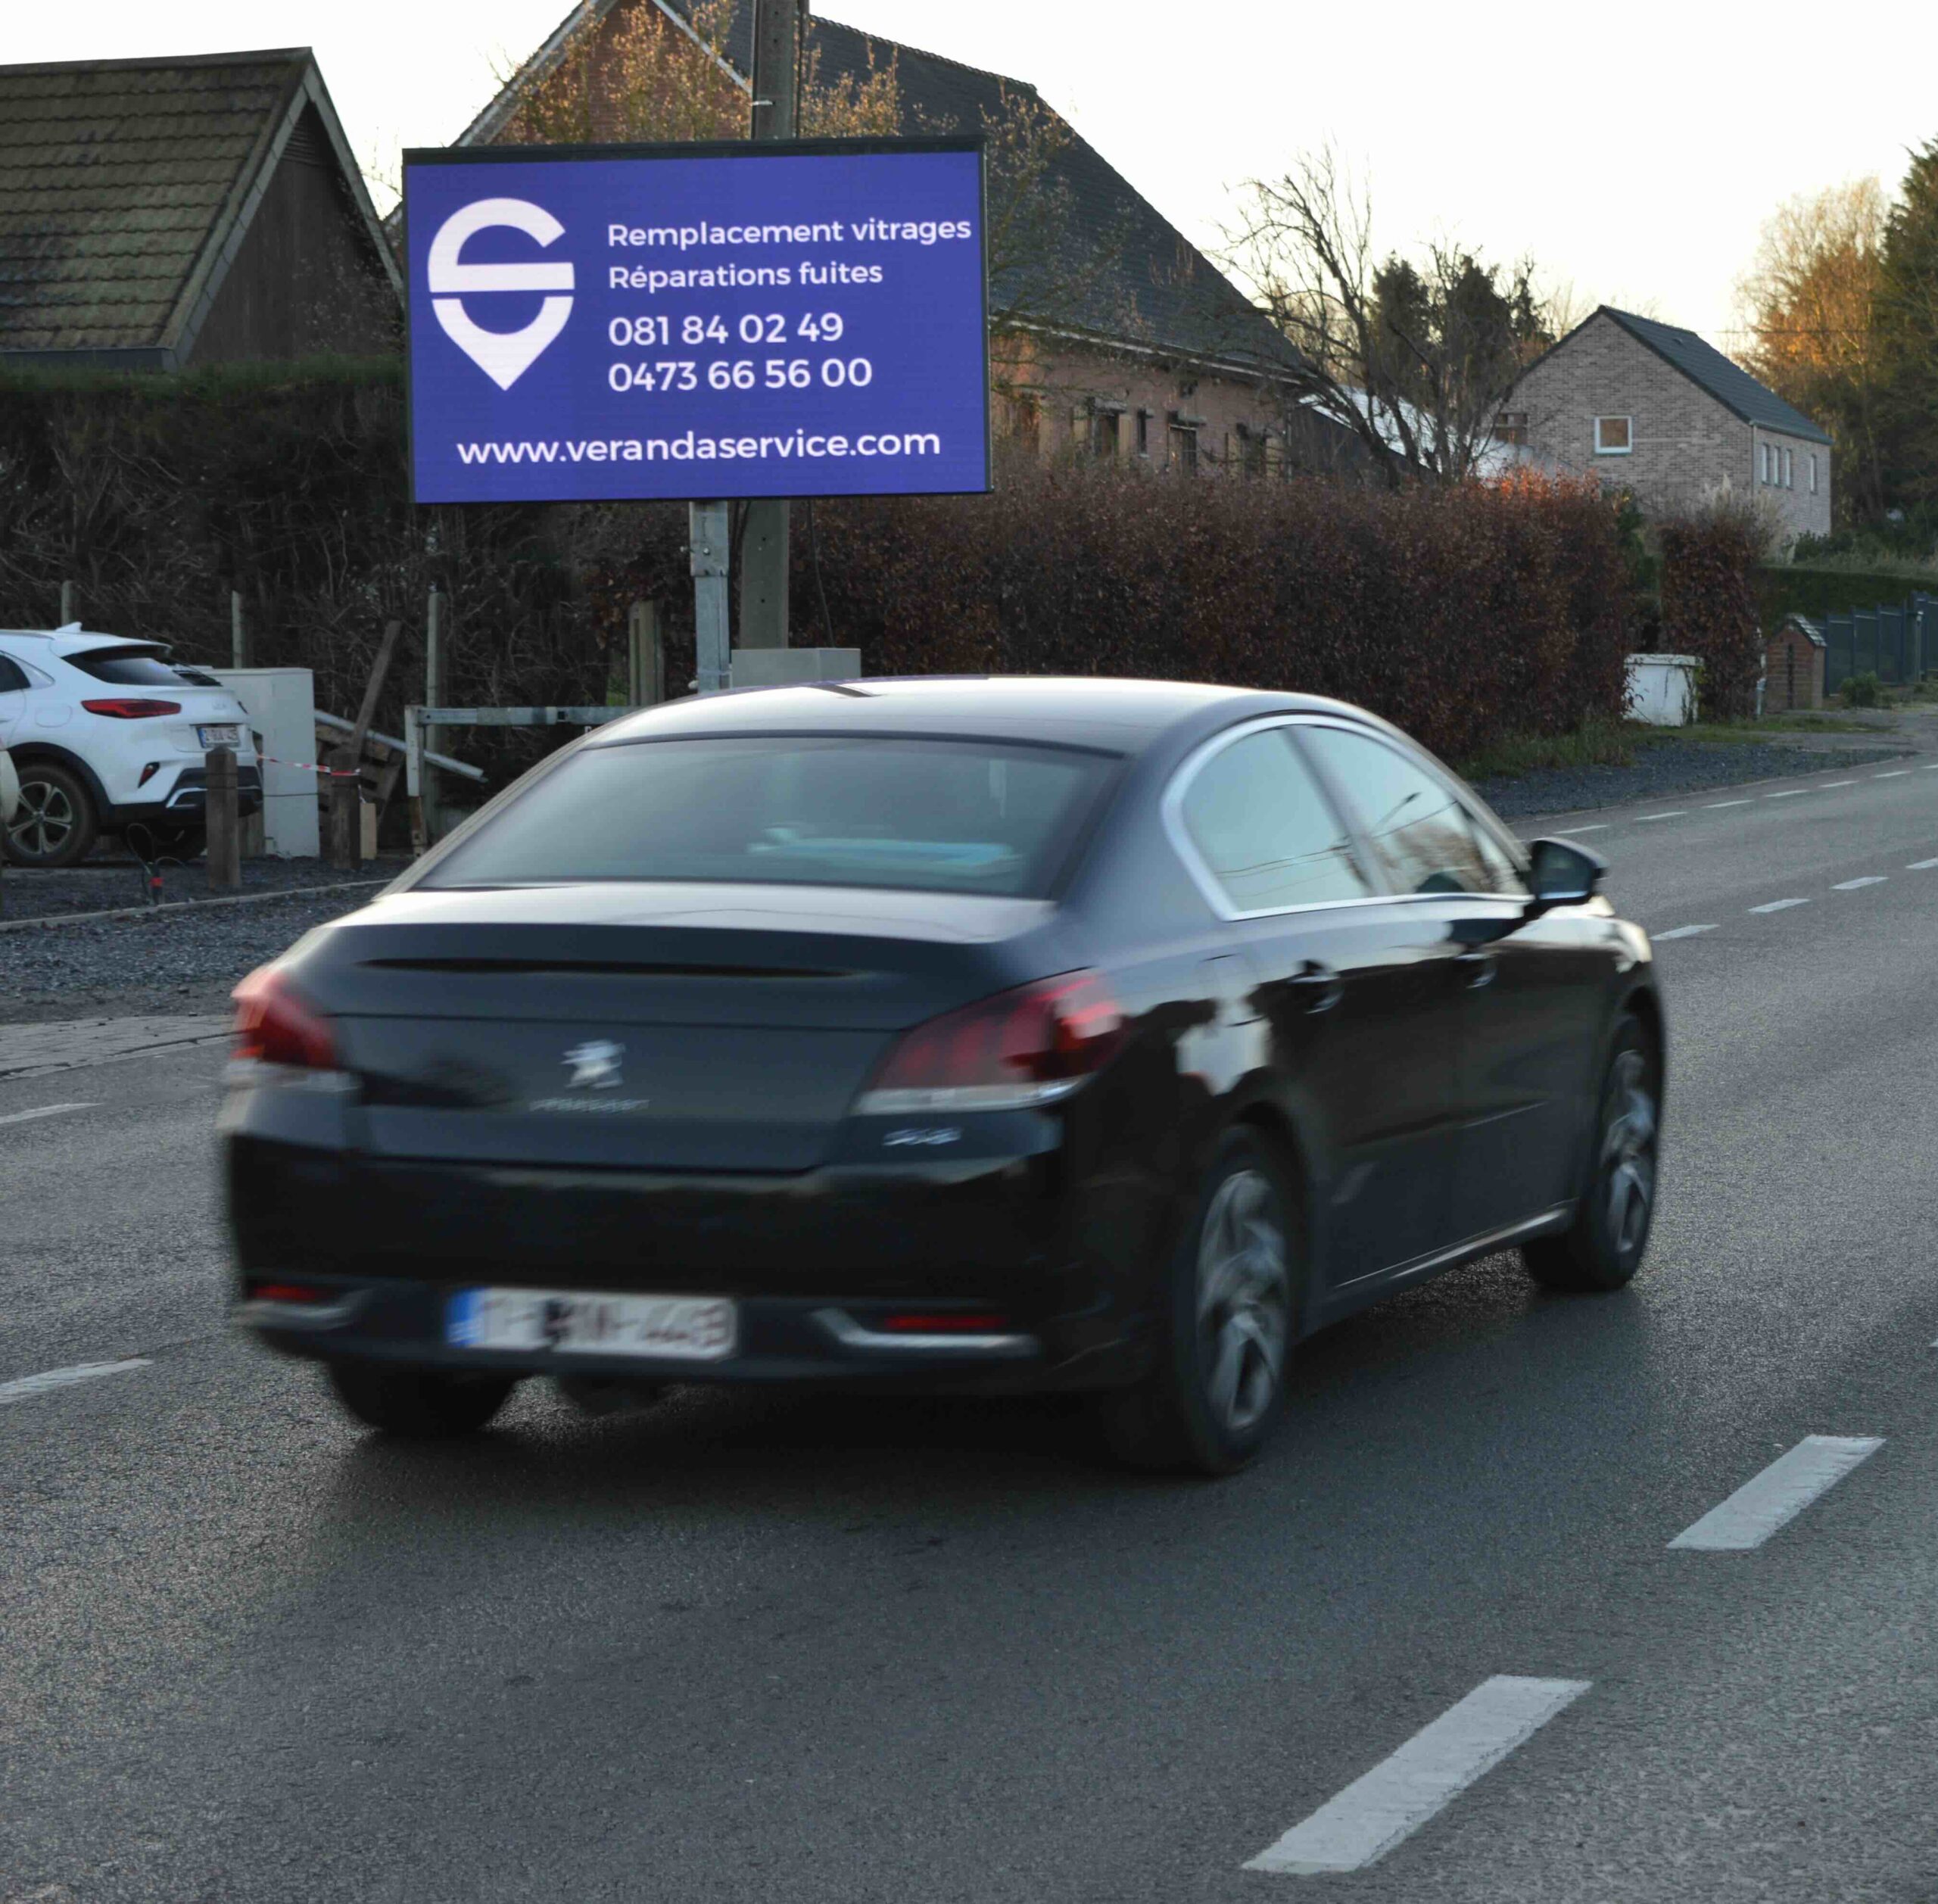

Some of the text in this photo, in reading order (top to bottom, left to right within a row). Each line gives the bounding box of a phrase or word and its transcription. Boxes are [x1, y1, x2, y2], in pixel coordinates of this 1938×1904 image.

[608, 217, 971, 250] Remplacement vitrages
[609, 260, 883, 293] Réparations fuites
[609, 312, 843, 346] 081 84 02 49
[608, 357, 873, 392] 0473 66 56 00
[456, 429, 940, 464] www.verandaservice.com
